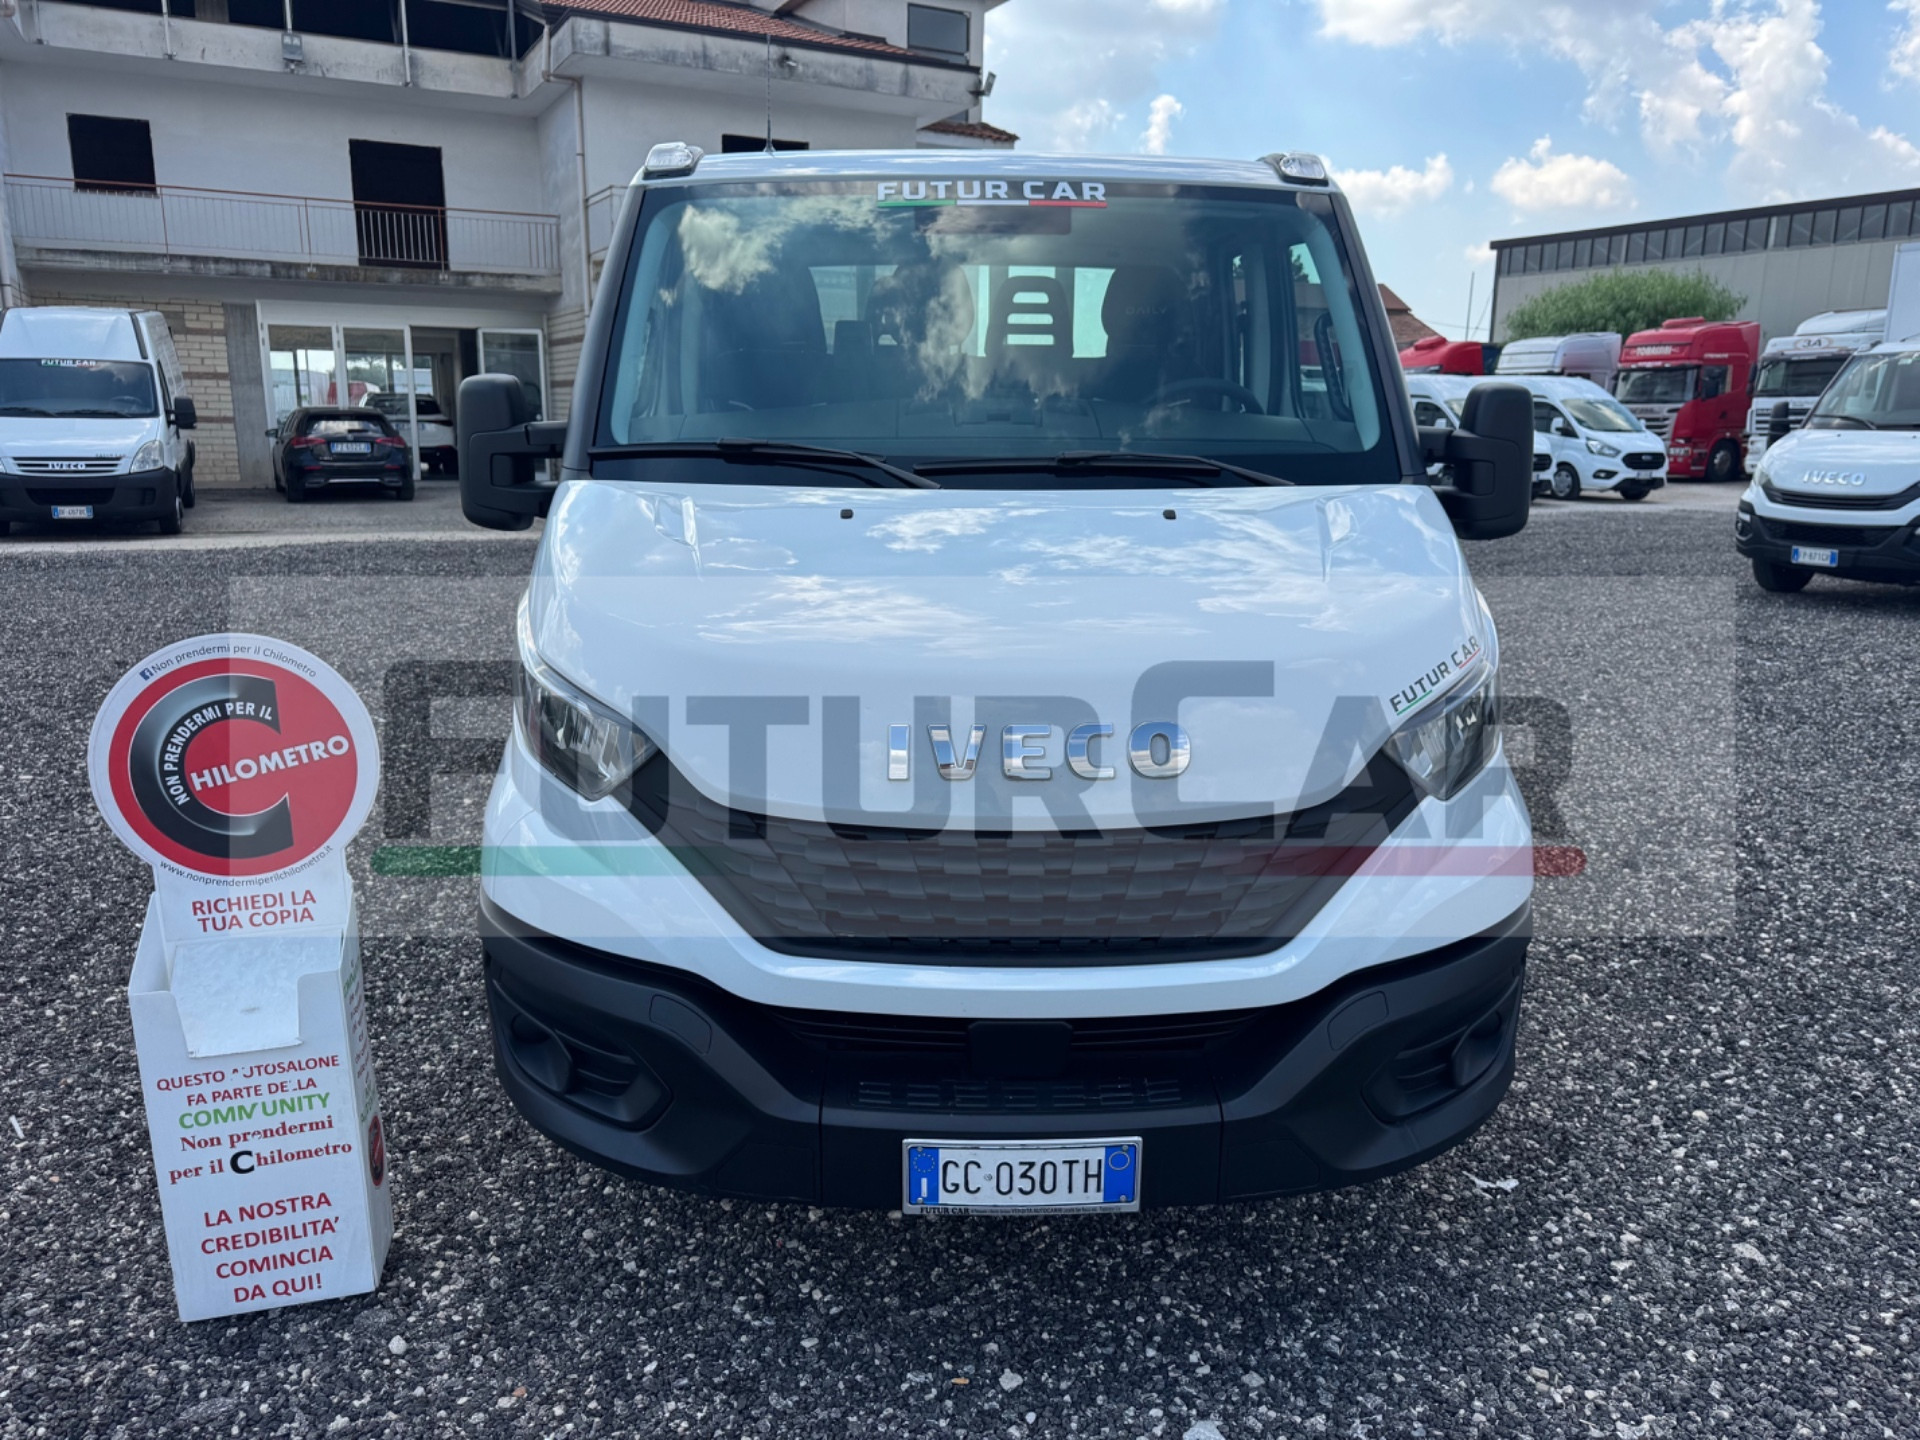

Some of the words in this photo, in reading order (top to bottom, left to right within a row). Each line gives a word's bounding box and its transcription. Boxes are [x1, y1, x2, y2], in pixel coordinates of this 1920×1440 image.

[876, 180, 1009, 200] FUTUR
[1022, 180, 1107, 201] CAR
[48, 462, 87, 470] IVECO
[1803, 470, 1866, 486] IVECO
[151, 658, 174, 674] Non
[175, 644, 231, 664] prendermi
[233, 645, 252, 655] per
[253, 645, 261, 655] il
[262, 647, 317, 678] Chilometro
[1389, 661, 1452, 713] FUTUR
[1450, 636, 1479, 668] CAR
[225, 701, 256, 716] PER
[259, 704, 273, 720] IL
[163, 704, 222, 772] PRENDERMI
[888, 721, 1191, 781] IVECO
[164, 775, 191, 806] NON
[160, 845, 333, 887] www.nonprendermiperilchilometro.it
[191, 891, 285, 917] RICHIEDI
[291, 889, 317, 906] LA
[197, 914, 243, 933] TUA
[248, 907, 315, 928] COPIA
[156, 1070, 226, 1092] QUESTO
[186, 1093, 208, 1107] FA
[211, 1084, 263, 1104] PARTE
[180, 1135, 223, 1152] Non
[228, 1115, 334, 1149] prendermi
[168, 1164, 204, 1185] per
[209, 1158, 224, 1175] il
[229, 1142, 353, 1175] Chilometro
[203, 1209, 233, 1228] LA
[238, 1192, 333, 1223] NOSTRA
[920, 1207, 949, 1215] FUTUR
[951, 1207, 971, 1215] CAR
[215, 1245, 335, 1280] COMINCIA
[233, 1283, 267, 1304] DA
[271, 1272, 323, 1297] QUI!
